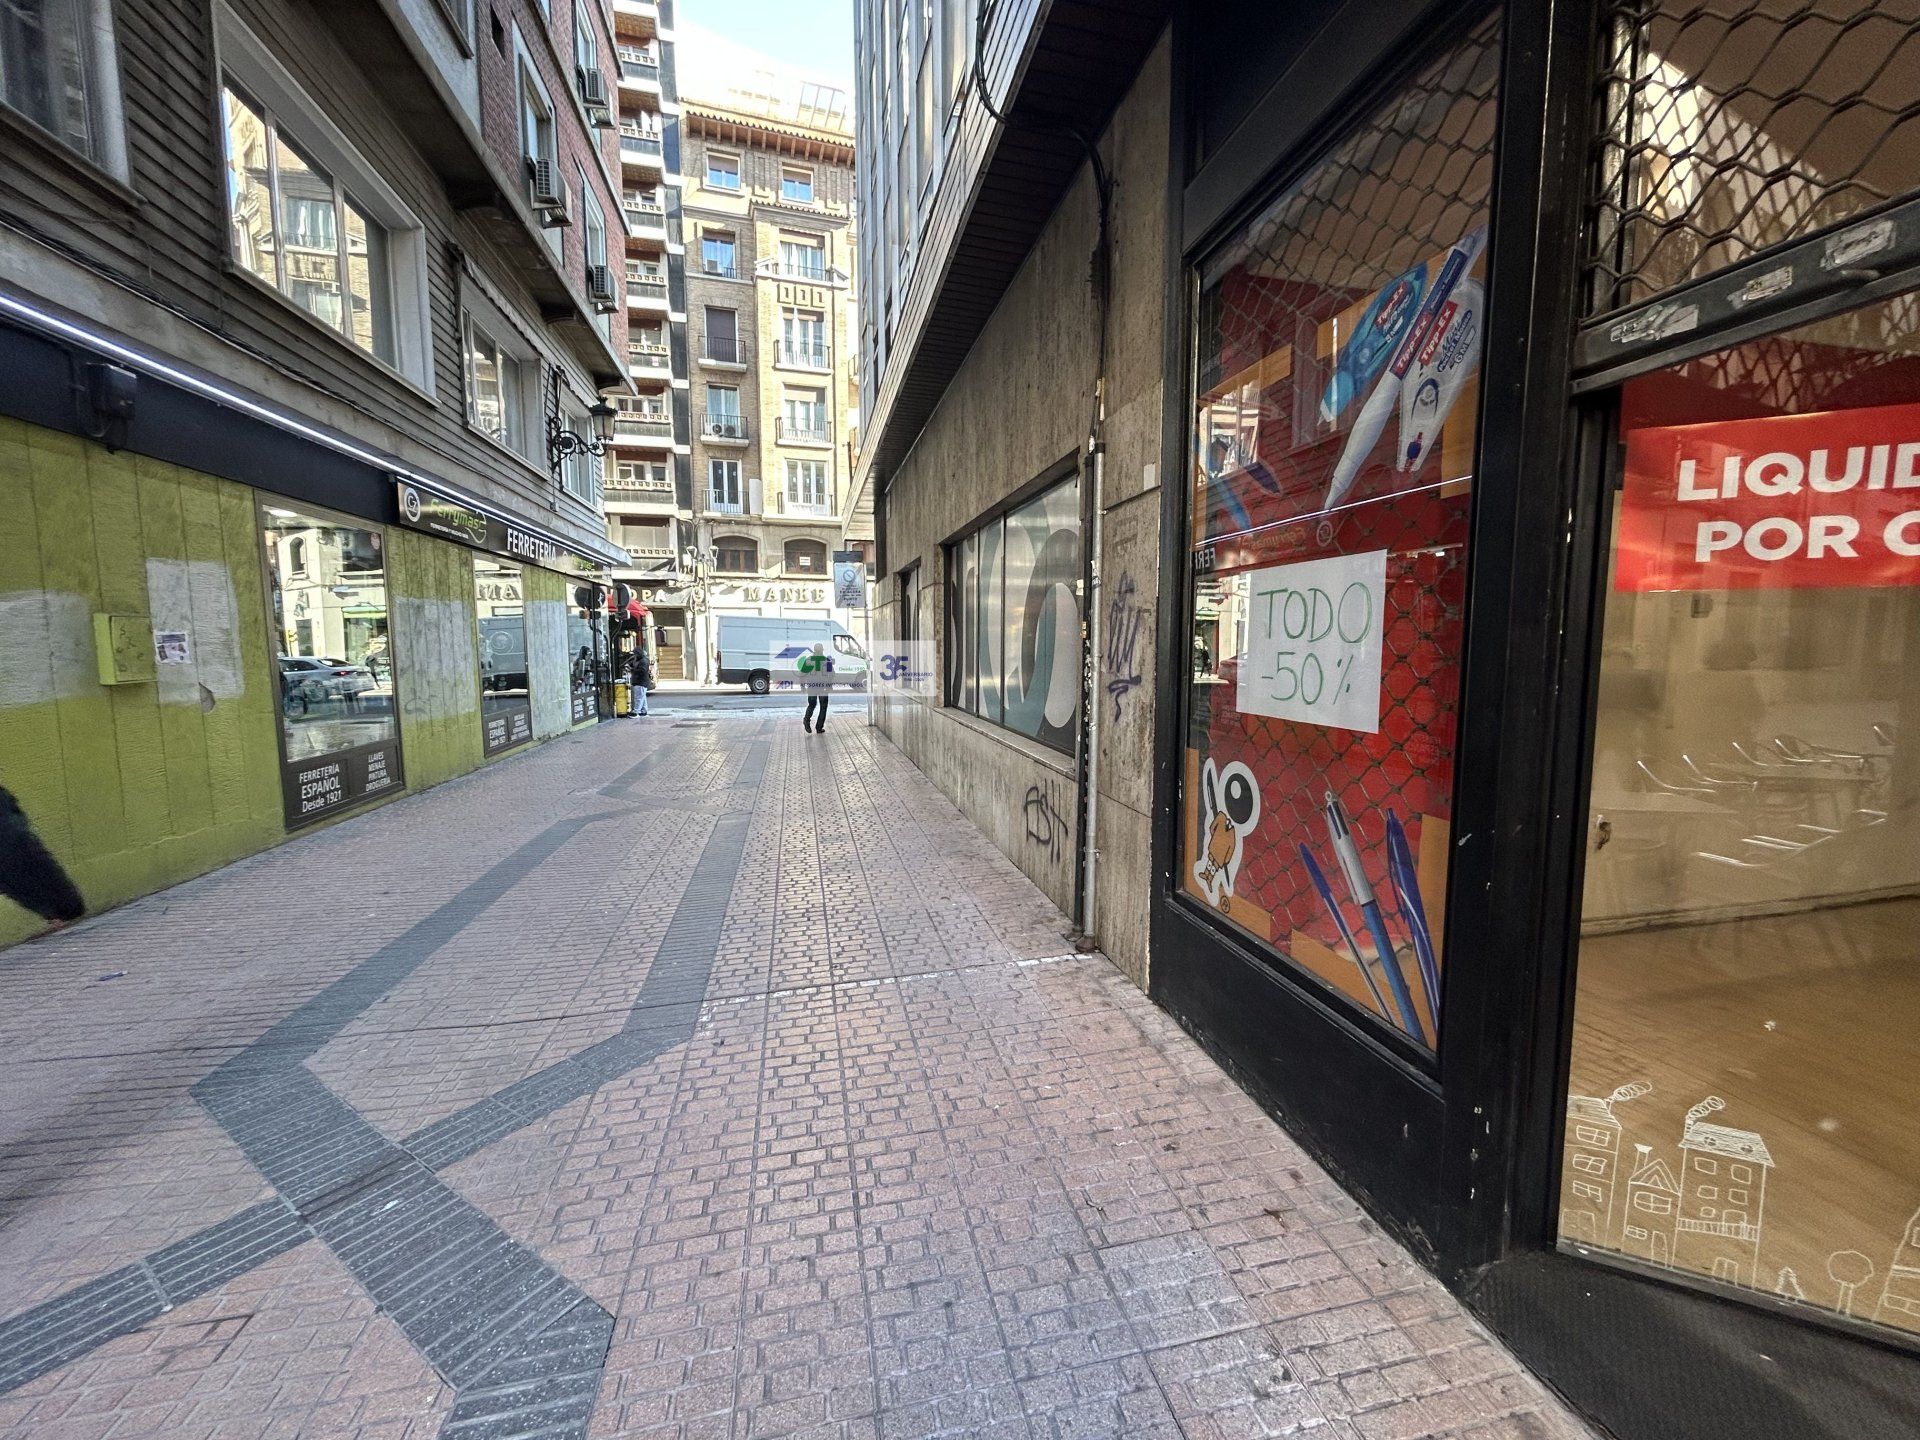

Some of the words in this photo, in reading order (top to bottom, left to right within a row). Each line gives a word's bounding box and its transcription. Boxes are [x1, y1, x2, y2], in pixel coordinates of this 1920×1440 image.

[1695, 515, 1859, 563] POR
[1256, 582, 1373, 643] TODO
[299, 763, 340, 784] FERRETERÍA
[301, 775, 341, 799] ESPAÑOL
[302, 796, 325, 813] Desde
[326, 789, 342, 804] 1921
